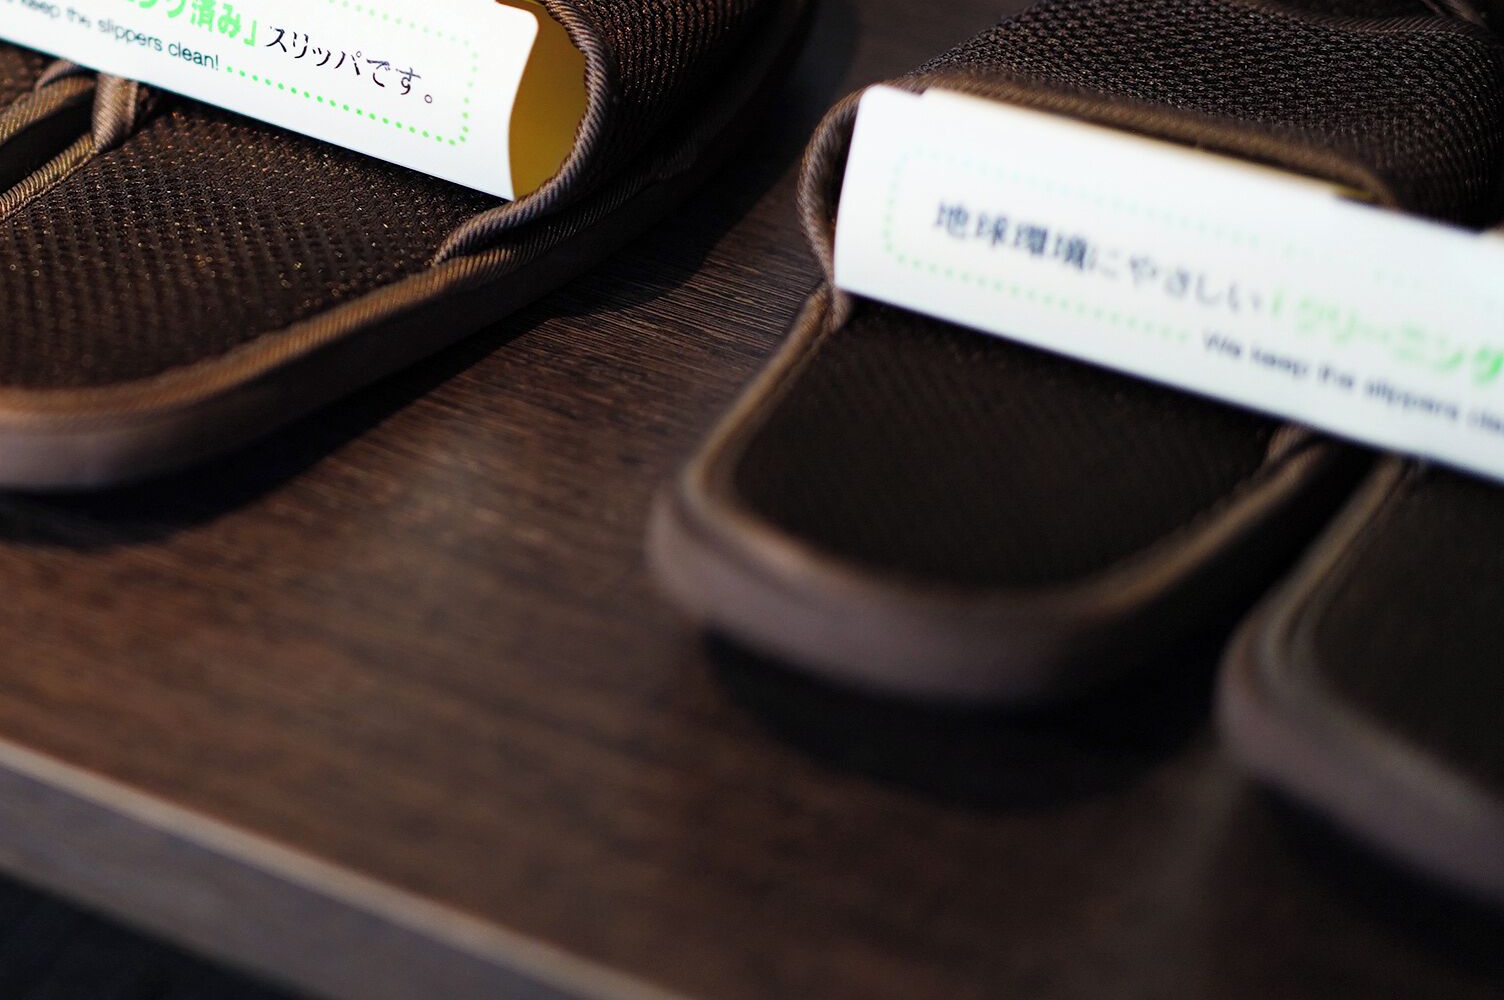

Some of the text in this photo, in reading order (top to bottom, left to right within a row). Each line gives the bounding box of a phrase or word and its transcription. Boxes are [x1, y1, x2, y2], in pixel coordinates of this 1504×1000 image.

[67, 6, 92, 30] the
[98, 16, 163, 53] slippers
[168, 41, 219, 71] clean!
[1204, 331, 1243, 358] We
[1250, 347, 1308, 378] keep
[1318, 363, 1356, 390] the
[1364, 377, 1459, 422] slippers
